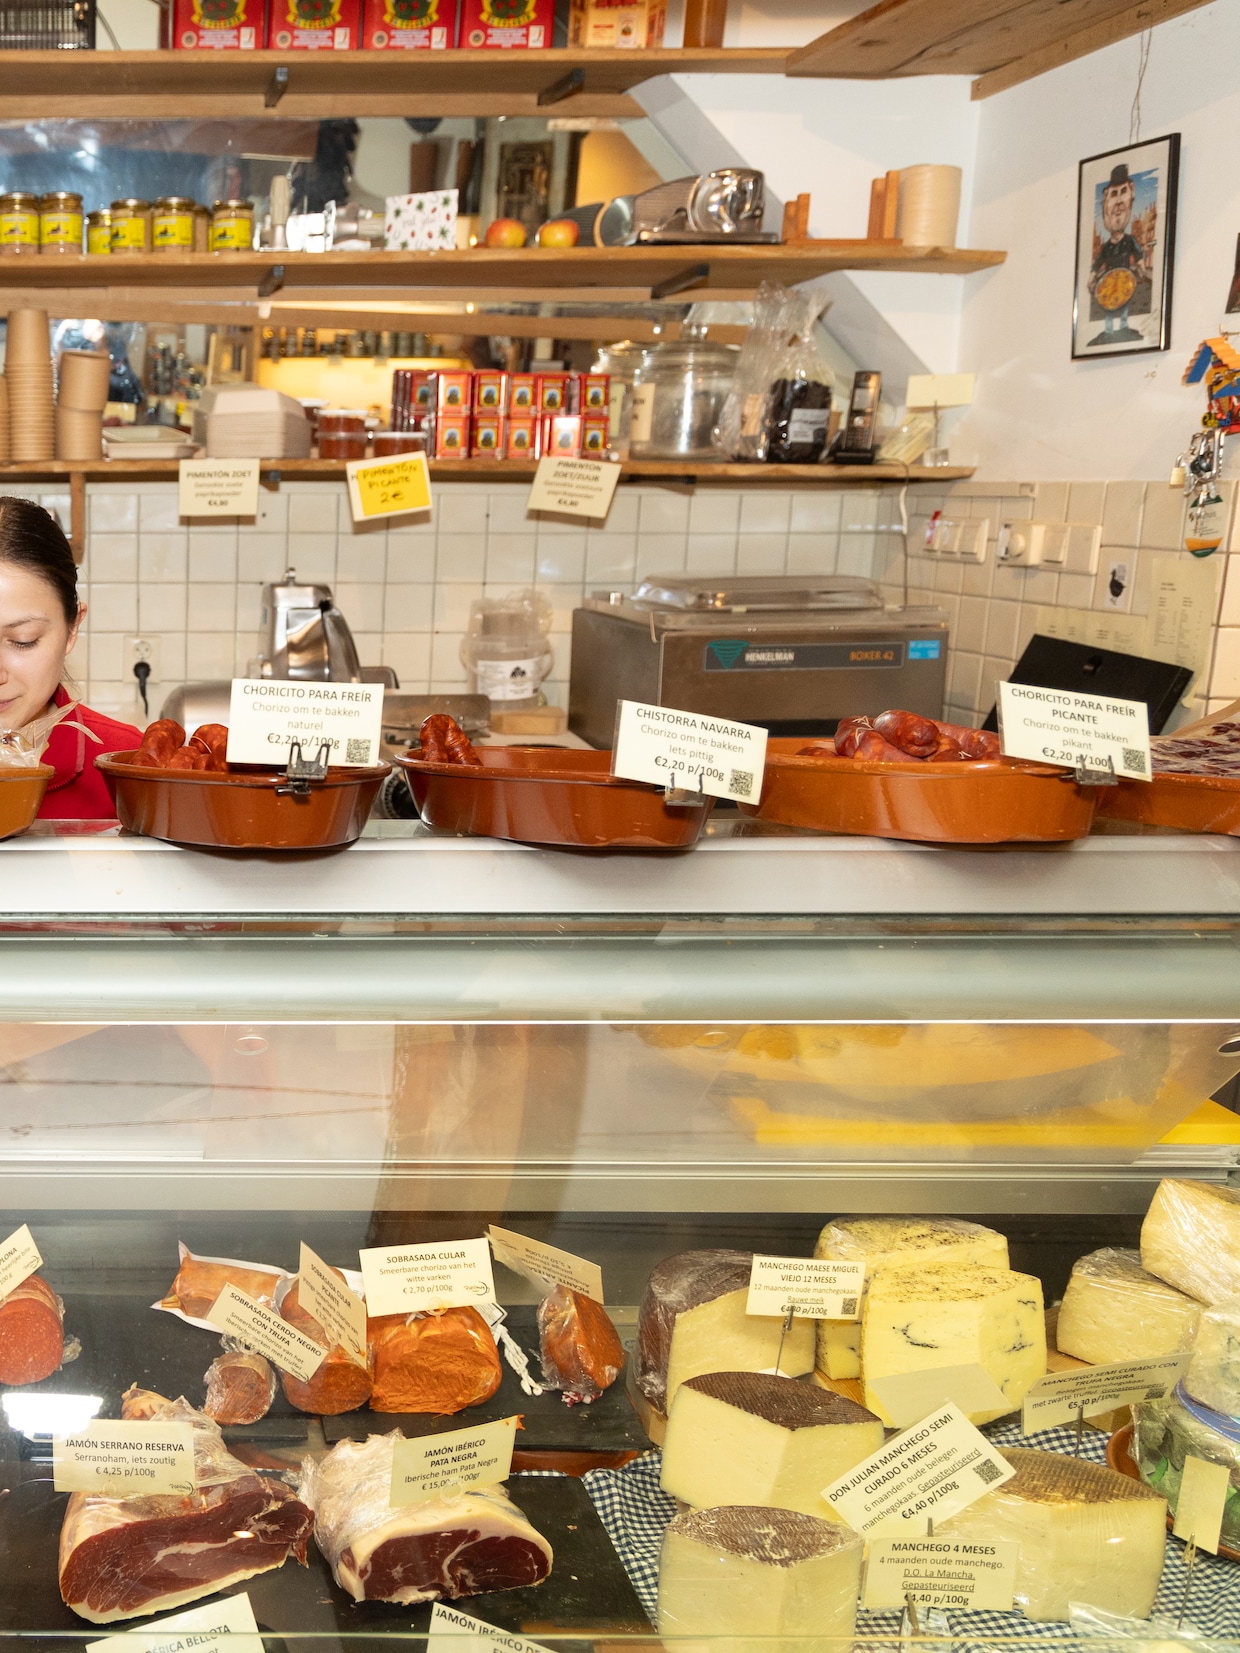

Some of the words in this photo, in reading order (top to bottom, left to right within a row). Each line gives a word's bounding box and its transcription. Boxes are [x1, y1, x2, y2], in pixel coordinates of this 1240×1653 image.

[745, 652, 795, 662] HENKELMAN
[883, 651, 894, 660] 42
[243, 685, 305, 698] CHORICITO
[309, 690, 338, 700] PARA
[342, 689, 372, 702] FREÍR
[252, 702, 290, 713] Chorizo
[293, 705, 309, 714] om
[312, 706, 322, 715] te
[325, 707, 360, 717] bakken
[1011, 688, 1071, 705] CHORICITO
[1074, 698, 1103, 712] PARA
[1106, 704, 1136, 717] FREÍR
[288, 720, 323, 730] naturel
[636, 708, 697, 728] CHISTORRA
[700, 721, 751, 740] NAVARRA
[1052, 709, 1098, 724] PICANTE
[641, 724, 677, 739] Chorizo
[680, 733, 695, 743] om
[699, 736, 707, 745] te
[711, 738, 744, 753] bakken
[1023, 717, 1060, 731] Chorizo
[1063, 725, 1078, 734] om
[1081, 727, 1091, 736] te
[1094, 729, 1128, 743] bakken
[1063, 739, 1092, 750] pikant
[669, 744, 686, 756] Iets
[689, 749, 714, 763] pittig
[655, 756, 685, 770] €2,20
[688, 765, 724, 781] p/100g
[387, 1254, 436, 1263] SOBRASADA
[439, 1251, 466, 1259] CULAR
[759, 1262, 804, 1270] MANCHEGO
[806, 1264, 830, 1272] MAESE
[229, 1292, 271, 1323] SOBRASADA
[272, 1318, 296, 1339] CERDO
[297, 1337, 322, 1357] NEGRO
[251, 1317, 268, 1330] CON
[268, 1329, 291, 1347] TRUFA
[66, 1439, 98, 1448] JAMÓN
[100, 1441, 142, 1450] SERRANO
[145, 1443, 185, 1451] RESERVA
[424, 1446, 454, 1458] JAMÓN
[455, 1439, 486, 1452] IBÉRICO
[430, 1459, 449, 1467] PATA
[451, 1452, 478, 1463] NEGRA
[829, 1483, 851, 1502] DON
[850, 1462, 880, 1487] JULIAN
[879, 1429, 931, 1467] MANCHEGO
[929, 1413, 953, 1433] SEMI
[864, 1465, 902, 1495] CURADO
[908, 1442, 938, 1465] MESES
[892, 1543, 951, 1553] MANCHEGO
[954, 1545, 959, 1553] 4
[962, 1546, 996, 1555] MESES
[901, 1581, 975, 1592] Gepasteuriseerd
